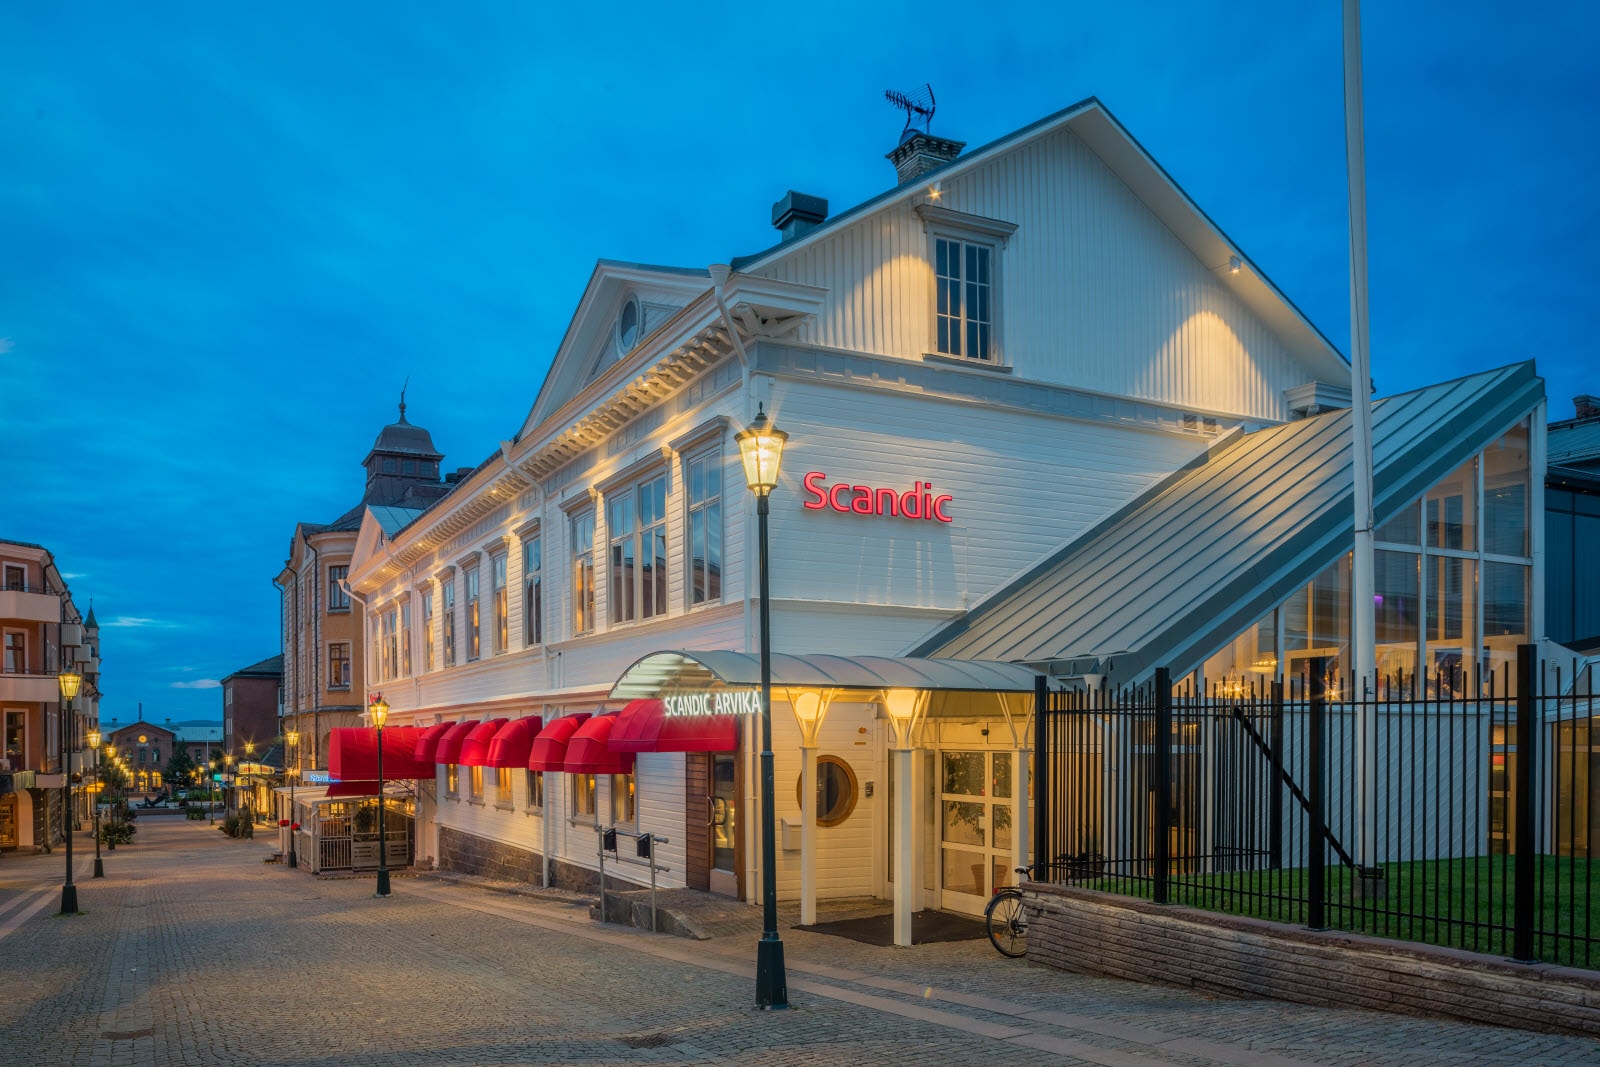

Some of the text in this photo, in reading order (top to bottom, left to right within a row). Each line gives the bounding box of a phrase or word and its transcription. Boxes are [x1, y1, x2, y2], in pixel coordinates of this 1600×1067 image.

[804, 471, 953, 523] Scandic
[664, 690, 762, 716] SCANDIC ARVIKA
